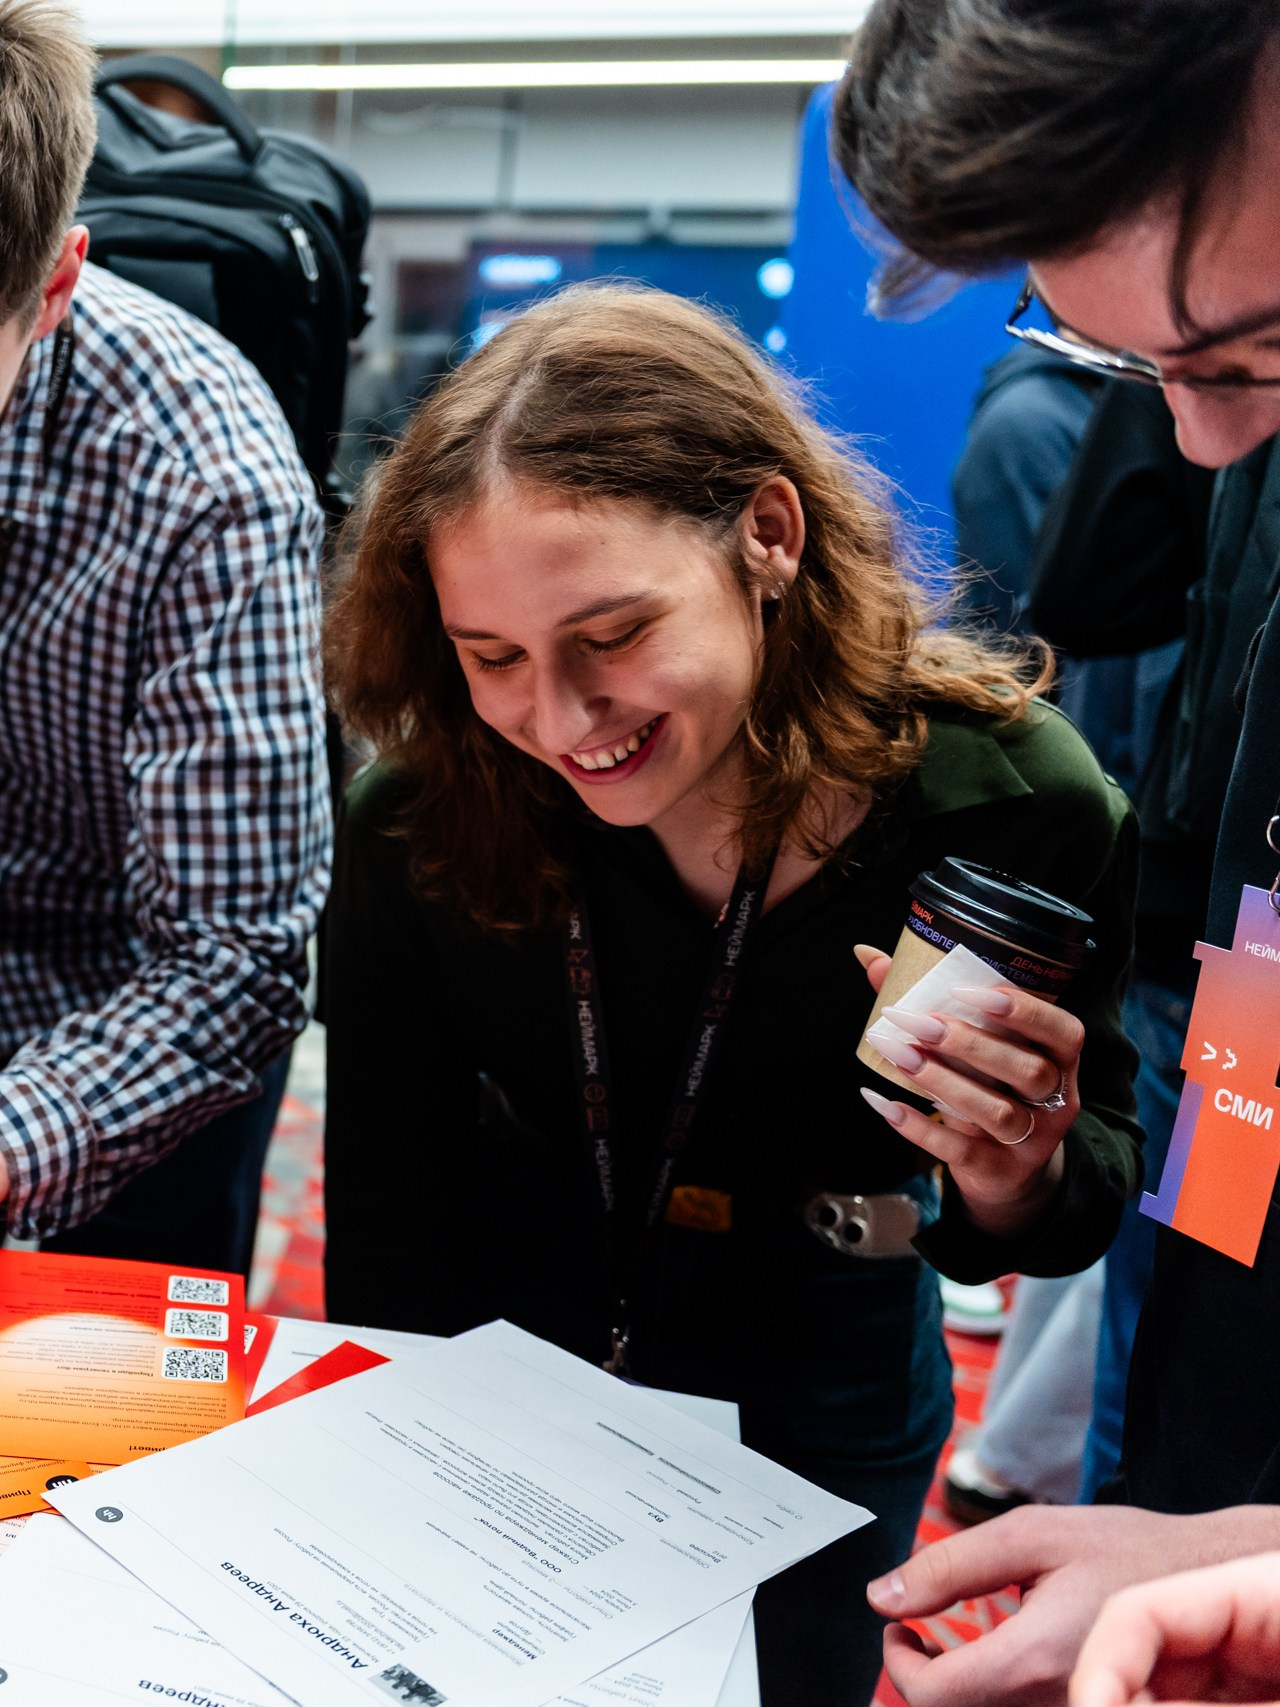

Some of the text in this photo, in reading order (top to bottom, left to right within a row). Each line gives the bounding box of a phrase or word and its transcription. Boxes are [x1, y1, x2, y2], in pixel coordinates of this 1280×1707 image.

[724, 890, 757, 967] НЕЙМАРК
[912, 918, 977, 955] ОБНОВЛЕ
[1009, 956, 1043, 975] ДЕНЬ
[1244, 940, 1280, 963] НЕЙМ
[578, 1000, 599, 1076] НЕЙМАРК
[685, 1024, 717, 1098] НЕЙМАРК
[1214, 1088, 1275, 1131] СМИ
[595, 1139, 615, 1212] НЕЙМАРК
[432, 1471, 463, 1490] насосов
[462, 1489, 495, 1510] продаже
[504, 1515, 549, 1545] менеджера
[647, 1512, 664, 1523] Вуз
[686, 1506, 755, 1545] Ключевые навыки
[473, 1517, 562, 1573] ООО "Водный поток"
[548, 1544, 580, 1565] Стажер
[659, 1538, 710, 1569] Образование
[689, 1543, 722, 1563] Высшее
[220, 1561, 368, 1669] Андрюха Андреев
[492, 1628, 537, 1660] Менеджер
[138, 1680, 225, 1707] ндреев
